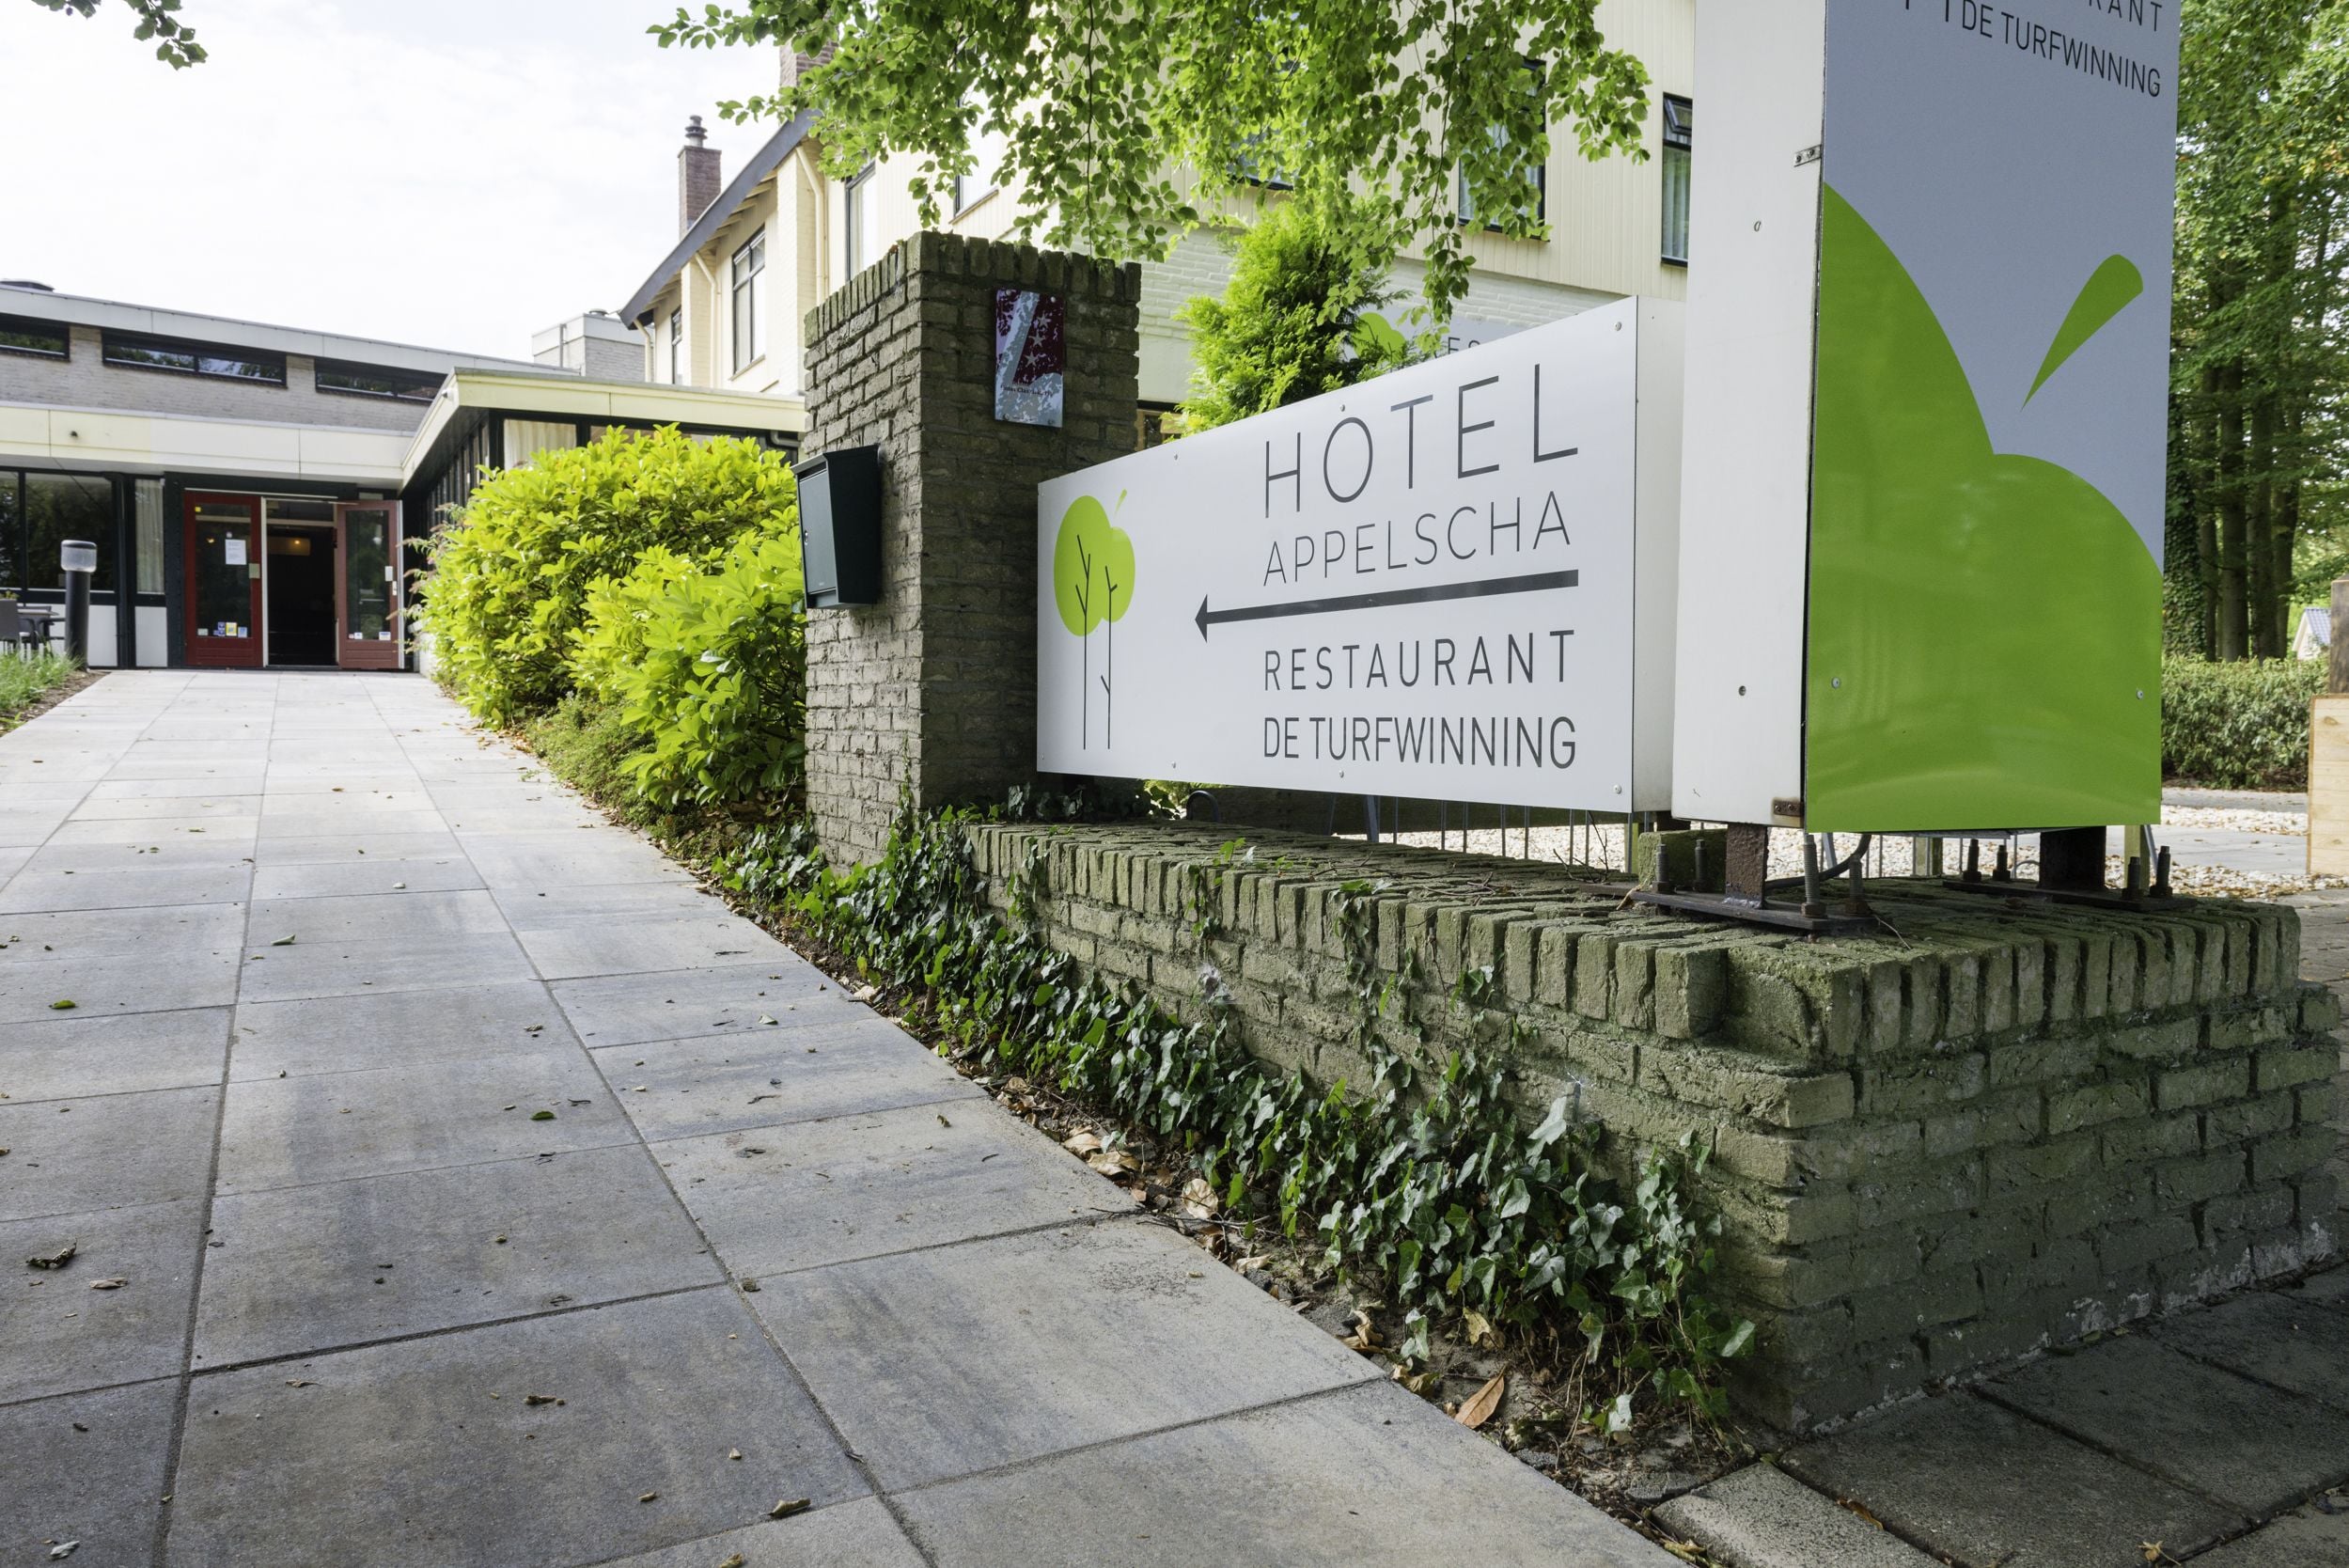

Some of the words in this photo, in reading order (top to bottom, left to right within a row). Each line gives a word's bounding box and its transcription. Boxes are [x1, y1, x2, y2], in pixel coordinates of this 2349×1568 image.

[1961, 0, 1994, 39] DE
[2000, 11, 2161, 98] TURFWINNING
[1264, 363, 1578, 519] HOTEL
[1262, 491, 1571, 588] APPELSCHA
[1264, 629, 1575, 691] RESTAURANT
[1263, 716, 1300, 760] DE
[1308, 715, 1577, 770] TURFWINNING
